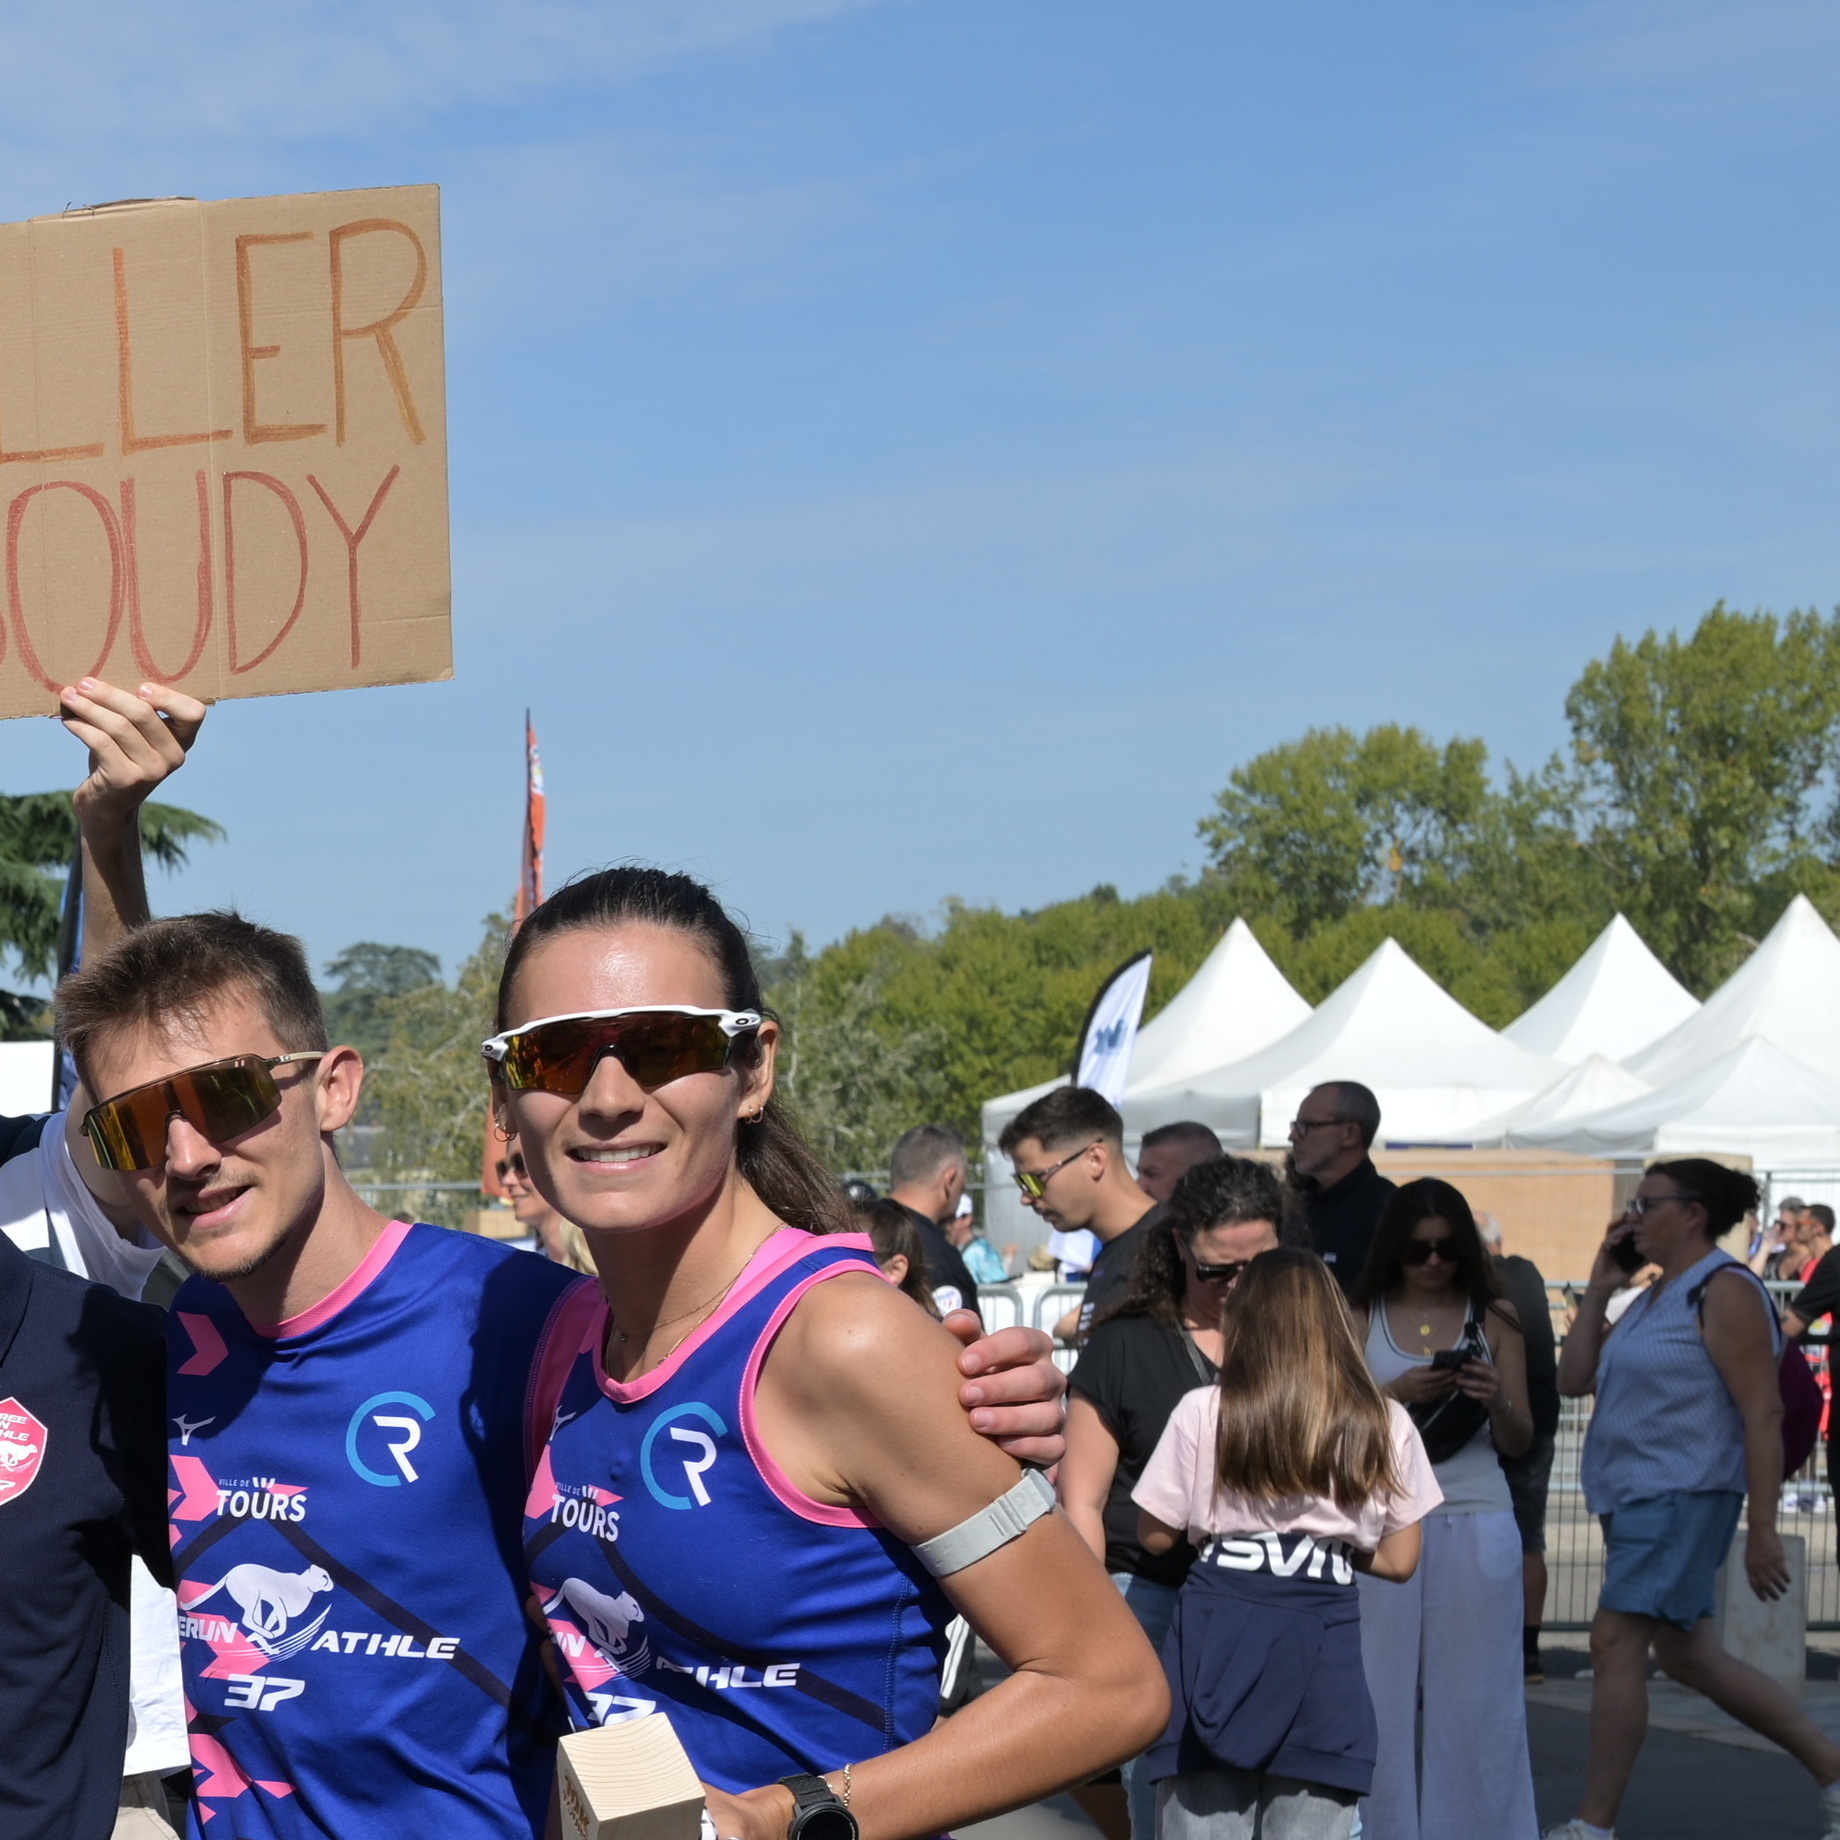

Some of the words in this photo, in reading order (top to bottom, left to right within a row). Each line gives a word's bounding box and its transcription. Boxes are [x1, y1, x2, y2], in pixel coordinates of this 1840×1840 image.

[219, 1478, 238, 1487] VILLE
[240, 1479, 250, 1487] DE
[216, 1489, 307, 1522] TOURS
[550, 1494, 619, 1542] TOURS
[178, 1616, 238, 1644] ERUN
[310, 1630, 460, 1660] ATHLE
[224, 1673, 306, 1712] 37
